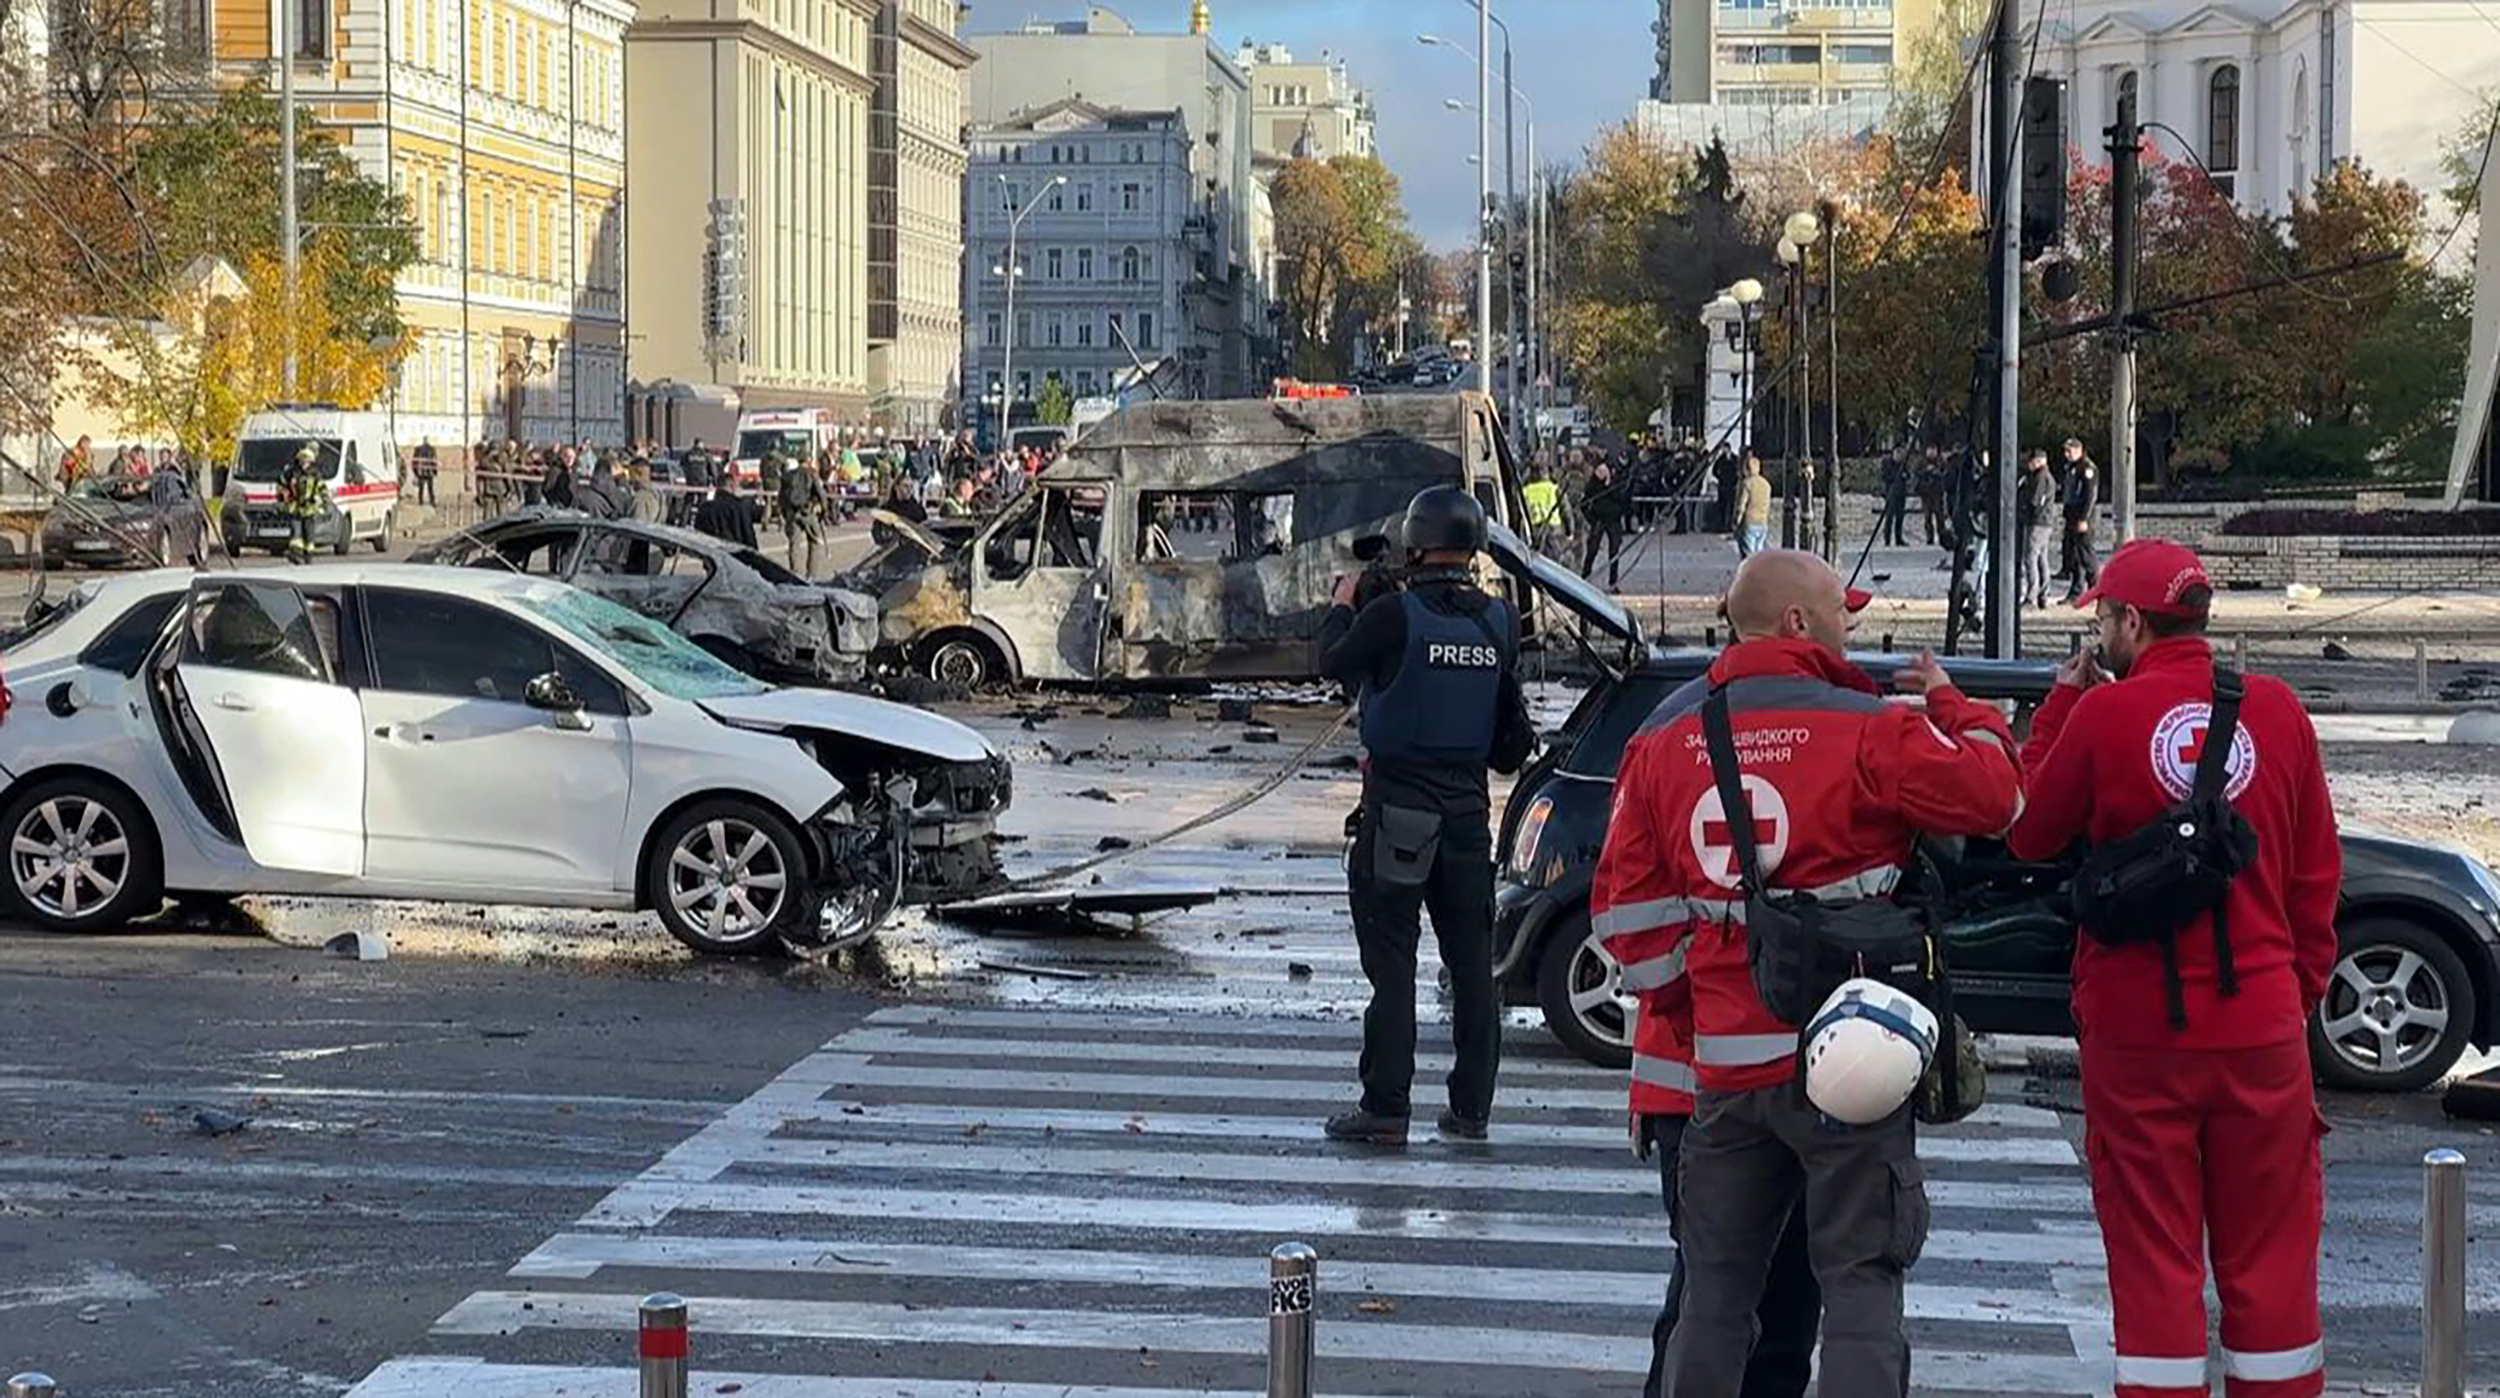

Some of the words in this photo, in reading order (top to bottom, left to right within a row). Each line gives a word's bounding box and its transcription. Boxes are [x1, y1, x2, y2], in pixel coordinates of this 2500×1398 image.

[1429, 644, 1497, 667] PRESS
[1696, 746, 1792, 766] РУВАННЯ
[1271, 1288, 1312, 1313] FKS
